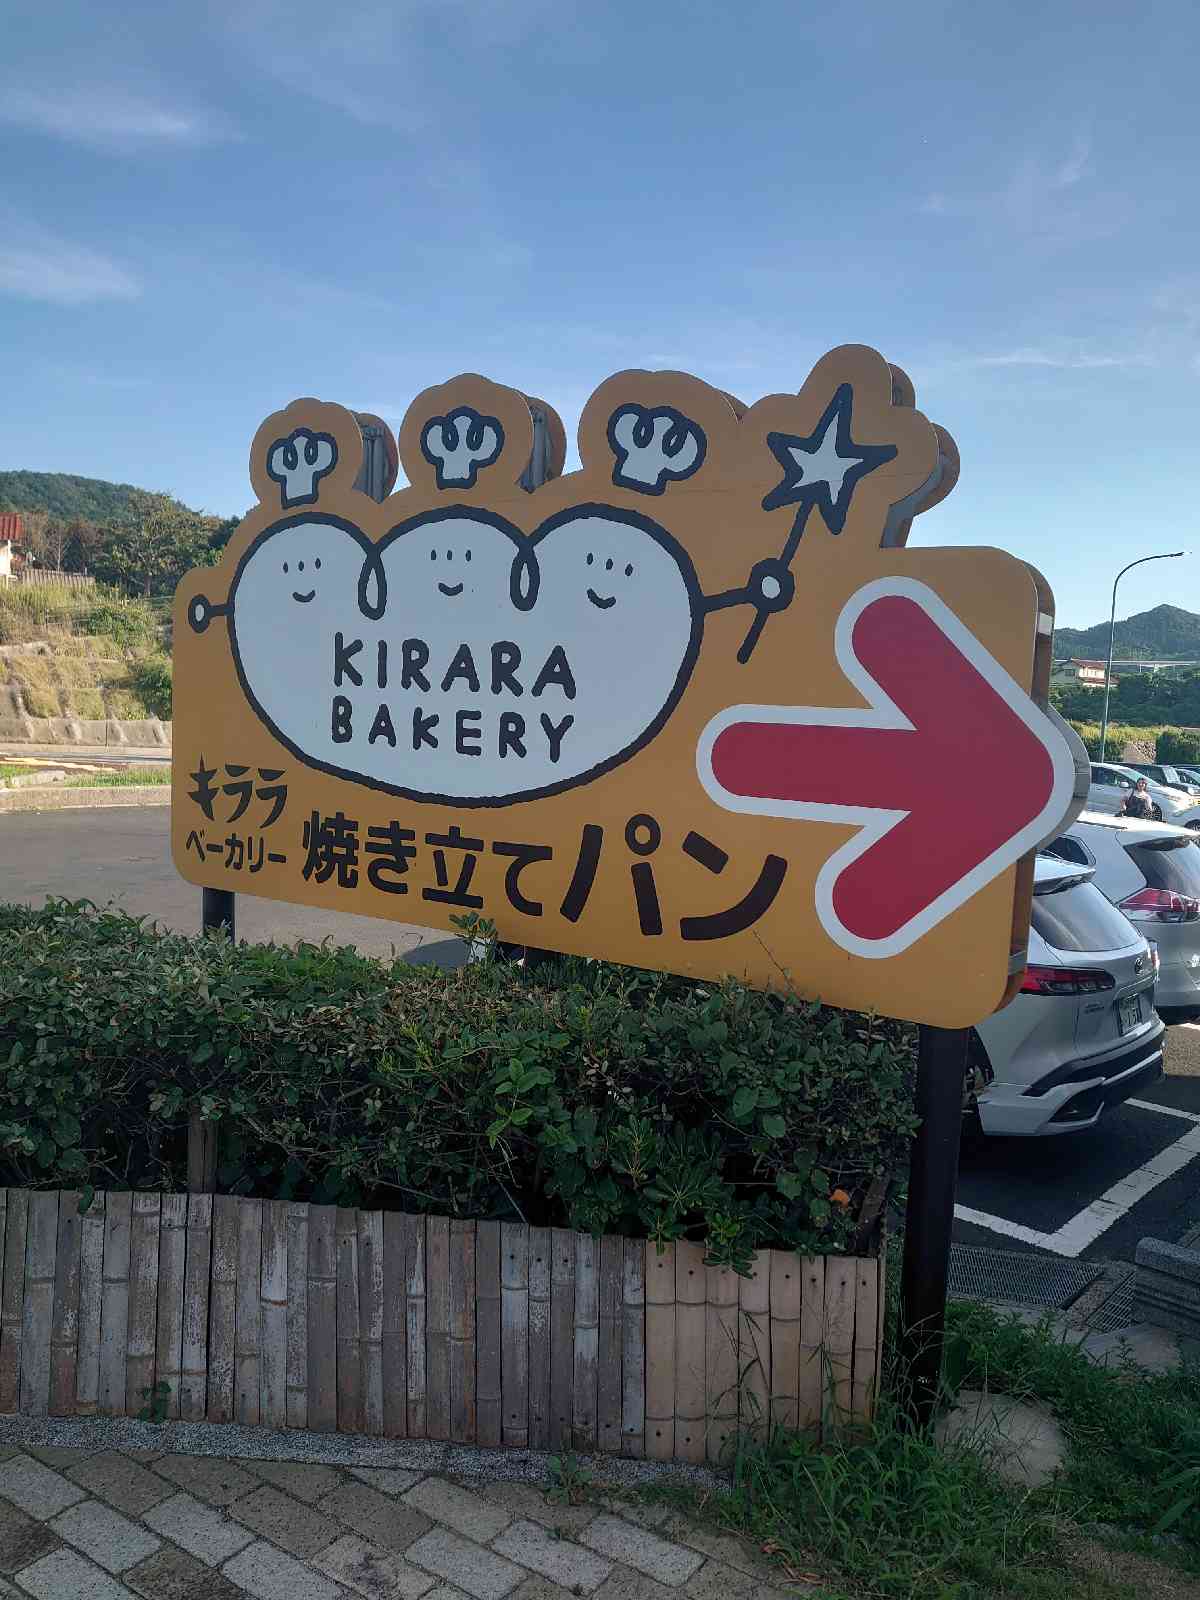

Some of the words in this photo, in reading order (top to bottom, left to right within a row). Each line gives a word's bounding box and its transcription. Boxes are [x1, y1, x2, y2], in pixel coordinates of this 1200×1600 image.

[334, 632, 577, 700] KIRARA
[331, 695, 575, 764] BAKERY
[186, 753, 288, 830] キララ
[186, 829, 287, 874] ベーカリー
[302, 810, 788, 942] 焼き立てパン
